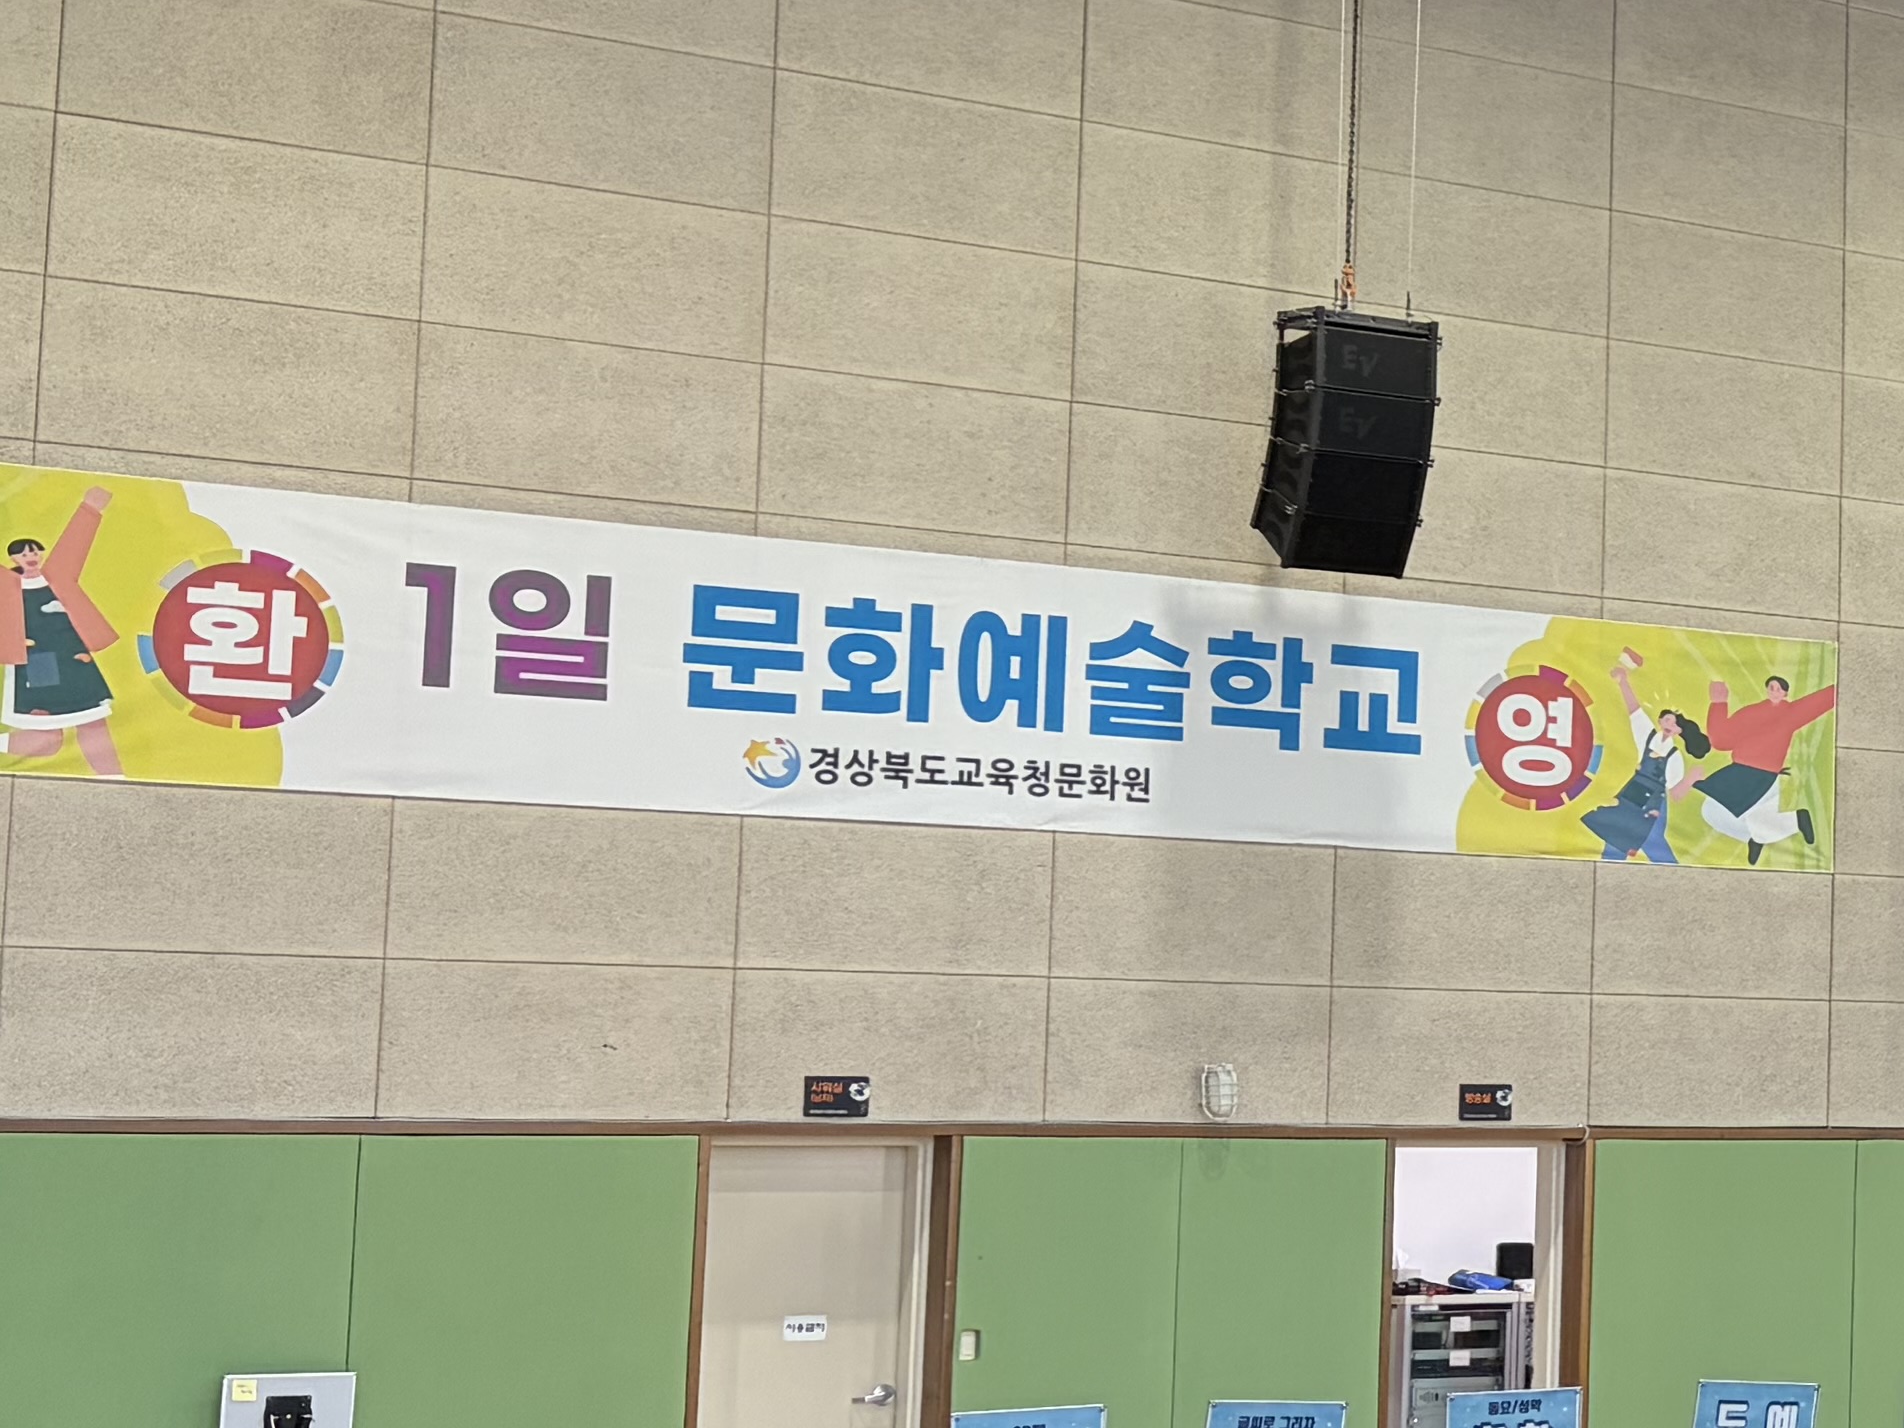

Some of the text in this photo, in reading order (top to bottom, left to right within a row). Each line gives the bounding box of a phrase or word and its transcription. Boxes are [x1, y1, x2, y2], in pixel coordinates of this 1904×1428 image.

[183, 562, 1573, 787] 환 1일 문화예술학교 영
[808, 746, 1151, 803] 경상북도교육청문화원
